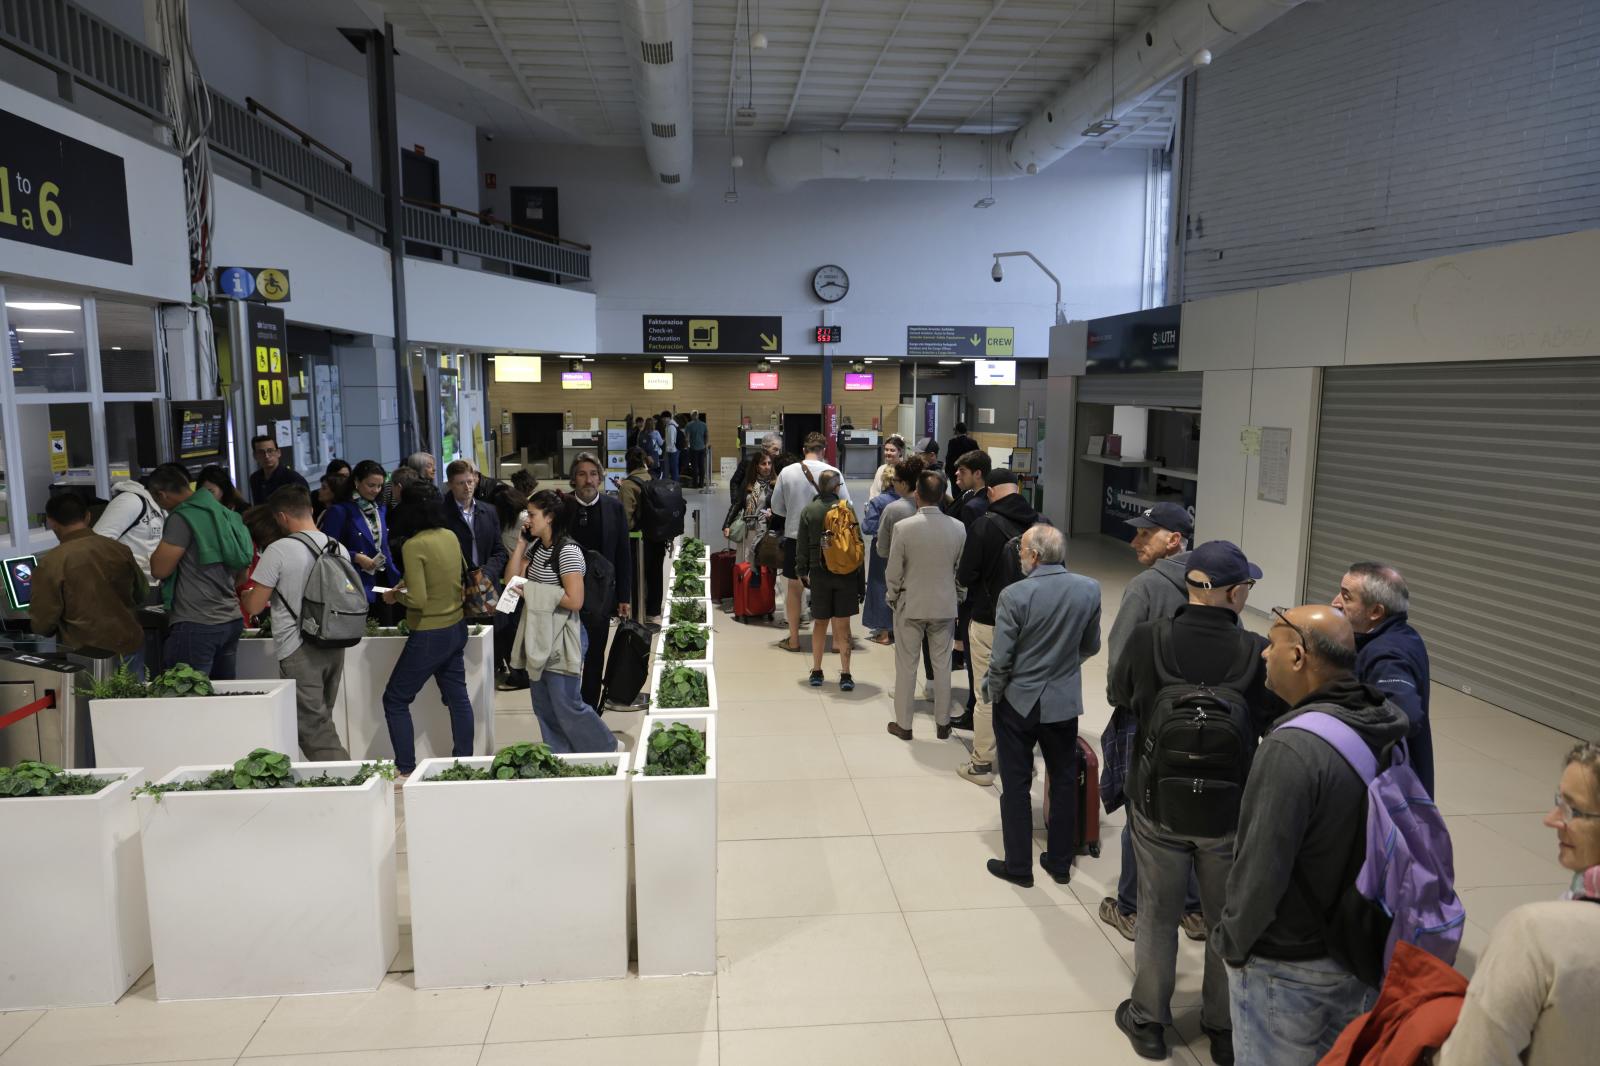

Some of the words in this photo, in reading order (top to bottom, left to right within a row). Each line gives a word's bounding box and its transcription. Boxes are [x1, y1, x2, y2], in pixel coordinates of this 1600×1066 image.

[0, 166, 18, 226] 1
[16, 171, 31, 194] to
[39, 181, 63, 236] 6
[21, 208, 34, 231] a
[987, 338, 1012, 346] CREW
[654, 361, 663, 371] 4
